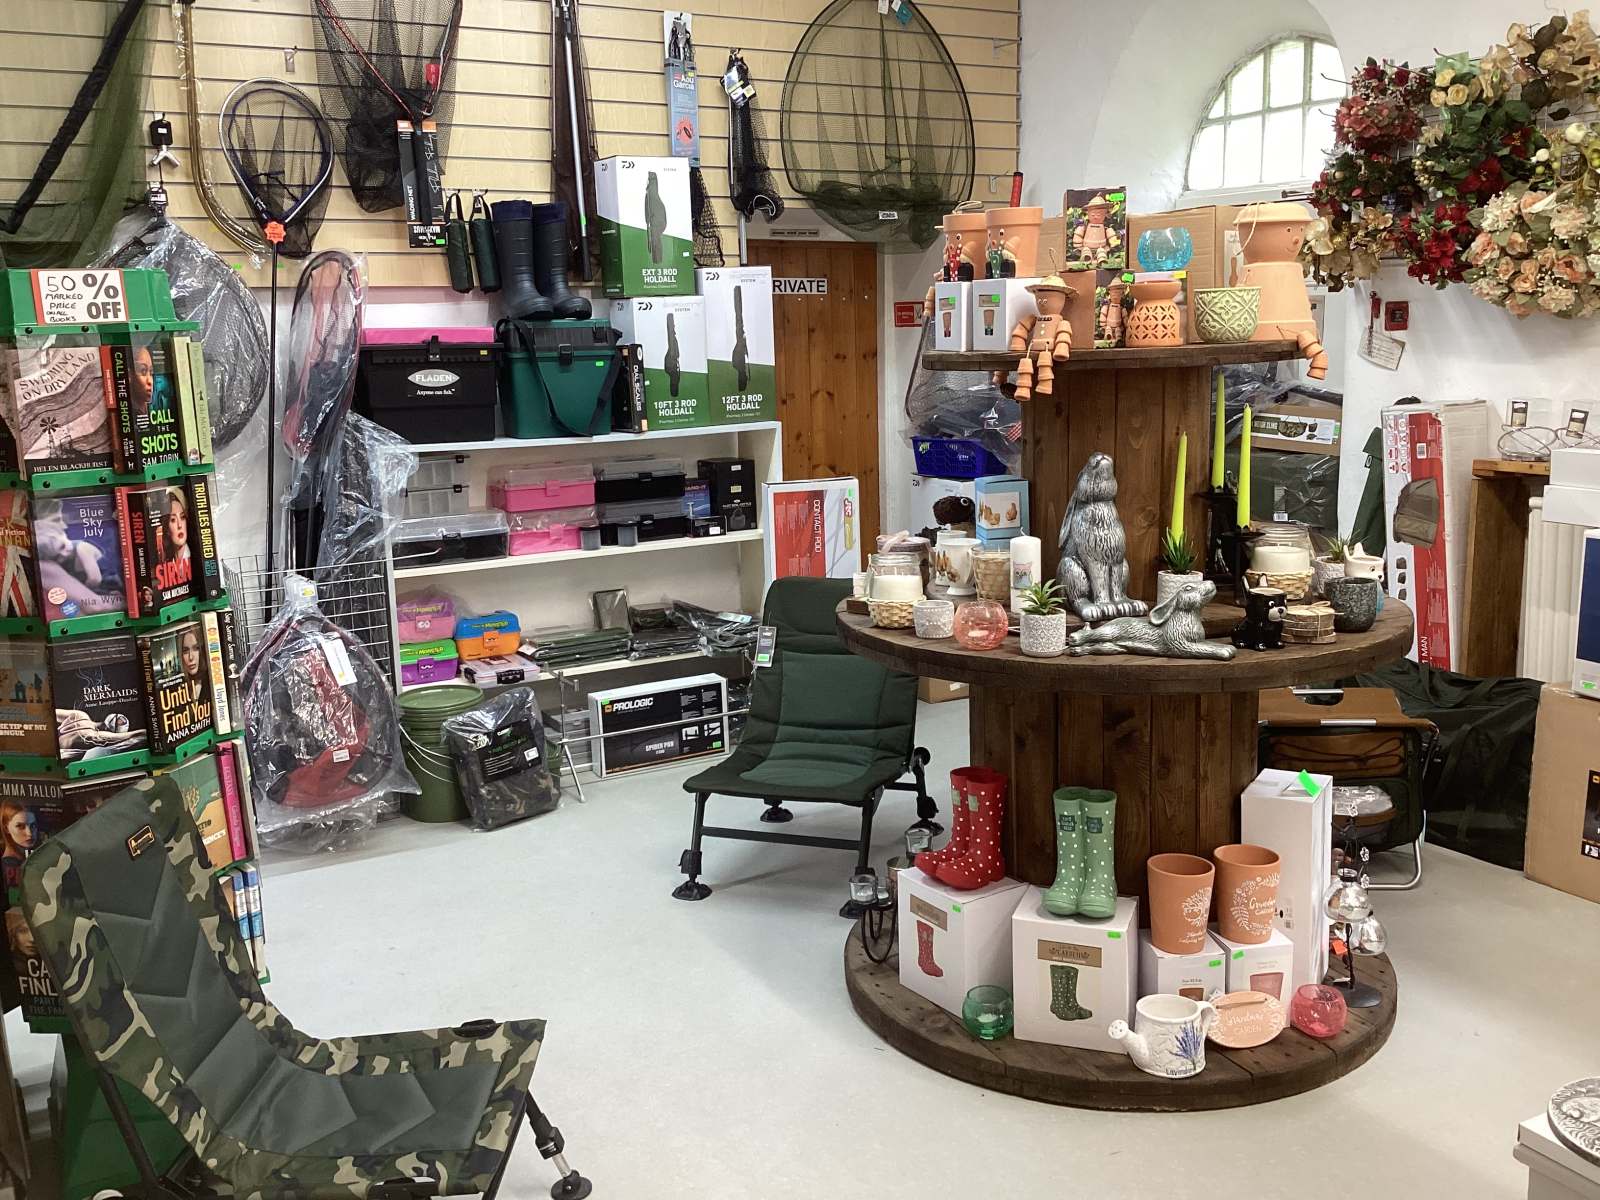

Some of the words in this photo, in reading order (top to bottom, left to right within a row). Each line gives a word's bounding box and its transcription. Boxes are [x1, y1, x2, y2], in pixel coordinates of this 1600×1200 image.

[408, 197, 416, 220] WADING
[772, 279, 827, 293] RIVATE
[87, 302, 122, 319] OFF
[114, 351, 123, 377] CALL
[22, 390, 41, 401] ON
[45, 379, 67, 394] DRY
[65, 352, 96, 377] LAND
[416, 374, 452, 382] FLADEN
[117, 380, 128, 399] THE
[634, 381, 642, 411] SCALES
[654, 401, 669, 409] 10FT
[671, 400, 677, 408] 3
[678, 399, 696, 408] ROD
[722, 396, 740, 405] 12FT
[741, 395, 747, 403] 3
[748, 394, 763, 402] ROD
[726, 402, 760, 412] HOLDALL
[120, 401, 131, 434] SHOTS
[149, 408, 175, 425] CALL
[658, 408, 694, 417] HOLDALL
[141, 433, 178, 455] SHOTS
[33, 465, 59, 473] HELEN
[142, 456, 157, 468] SAM
[159, 452, 179, 465] TOBIN
[194, 482, 207, 508] TRUTH
[80, 508, 104, 518] Blue
[82, 518, 103, 527] Sky
[198, 508, 210, 528] LIES
[813, 499, 822, 534] CONTACT
[84, 528, 104, 538] July
[132, 511, 146, 544] SIREN
[201, 528, 214, 559] BURIED
[155, 558, 192, 590] SIREN
[162, 590, 171, 601] SAM
[83, 684, 112, 695] DARK
[83, 688, 138, 702] MERMAIDS
[160, 684, 191, 711] Until
[191, 679, 197, 700] I
[148, 695, 156, 716] ANNA
[613, 697, 654, 712] PROLOGIC
[163, 708, 190, 734] Find
[191, 702, 211, 723] You
[151, 717, 160, 739] SMITH
[166, 729, 189, 744] ANNA
[190, 718, 211, 733] SMITH
[0, 783, 26, 796] MMA
[27, 958, 51, 978] CA
[19, 976, 58, 996] FINL
